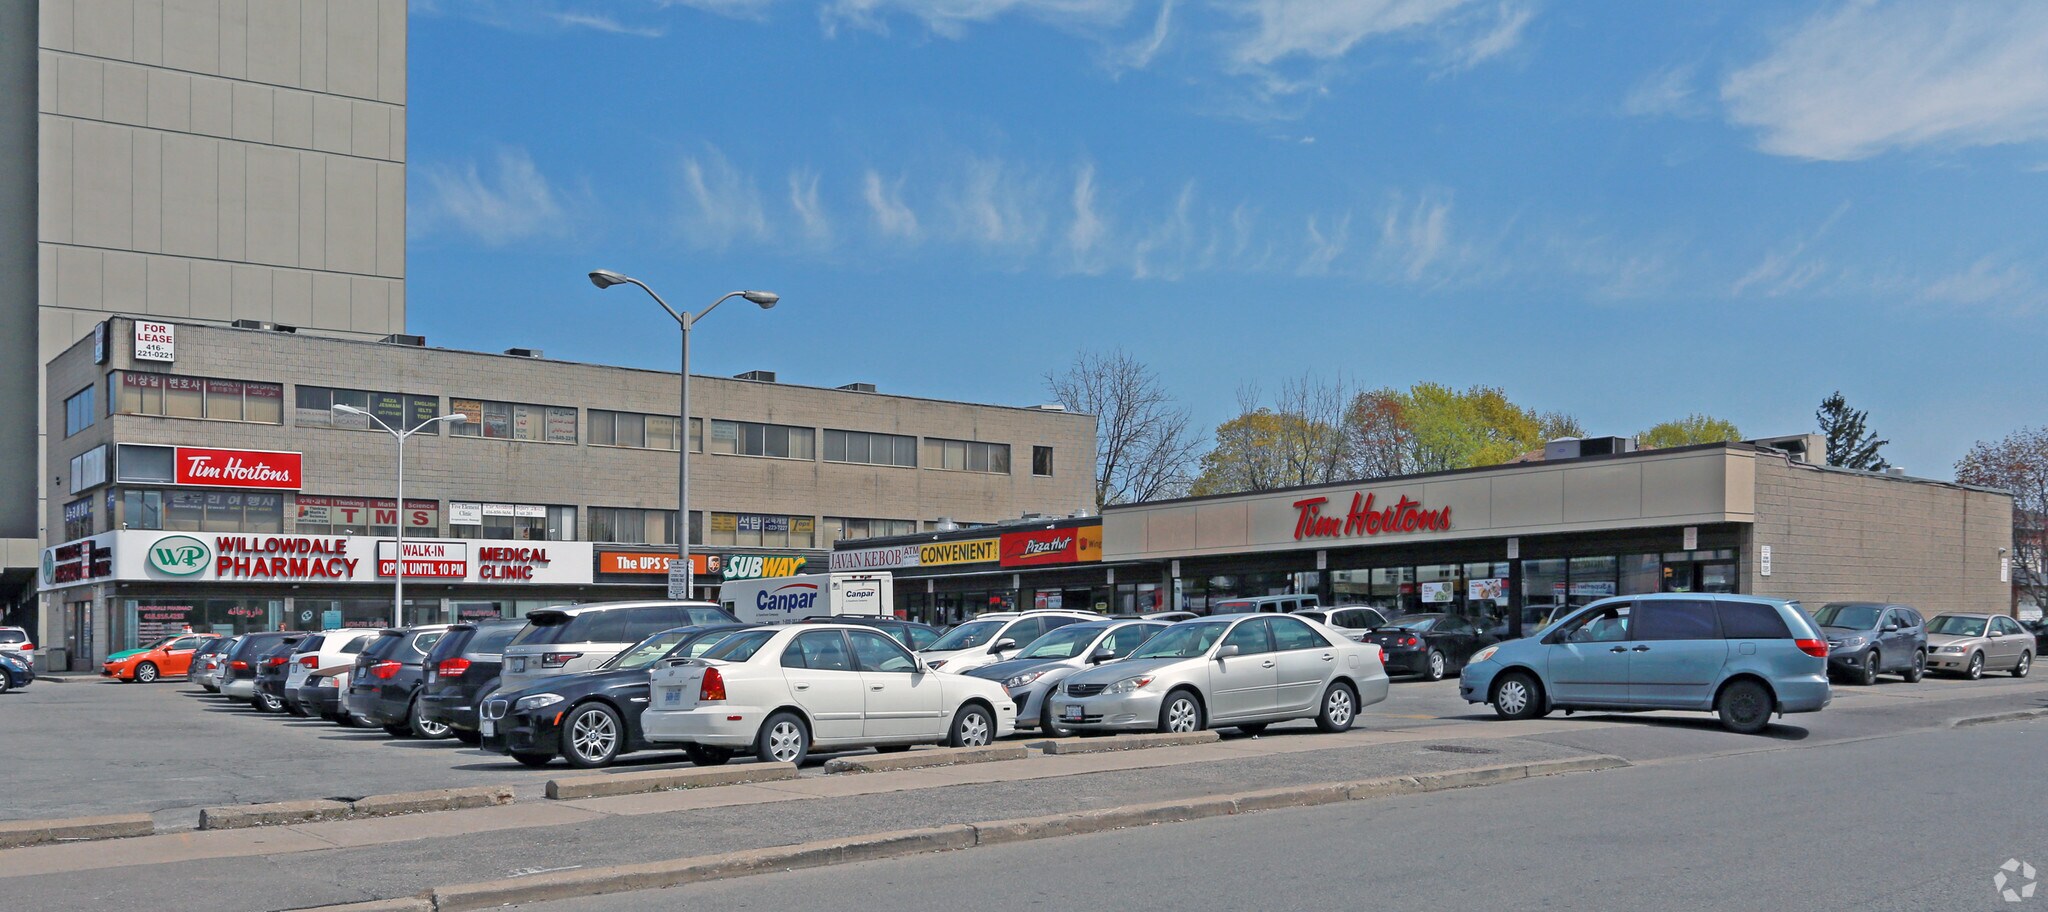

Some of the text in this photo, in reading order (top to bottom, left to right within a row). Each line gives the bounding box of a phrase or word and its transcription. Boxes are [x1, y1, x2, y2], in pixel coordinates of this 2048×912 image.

[144, 324, 166, 333] FOR
[138, 333, 172, 344] LEASE
[138, 350, 172, 358] 221-0221
[127, 374, 159, 387] 이상길
[169, 378, 200, 390] 변호사
[188, 456, 290, 482] Tim Hortons
[340, 509, 429, 525] T M S
[739, 516, 762, 530] 석탑
[1293, 491, 1452, 540] Tim Hortons
[216, 537, 347, 555] WILLOWDALE
[403, 544, 444, 557] WALK-IN
[904, 547, 919, 555] ATM
[921, 542, 992, 564] CONVENIENT
[1025, 536, 1072, 554] Pizza Hut
[156, 546, 204, 567] WP
[480, 547, 550, 562] MEDICAL
[830, 549, 902, 570] JAVAN KEBOB
[216, 556, 358, 578] PHARMACY
[382, 564, 464, 576] OPN UNTIL 10 PM
[617, 557, 637, 569] The
[640, 557, 660, 570] UPS
[724, 554, 807, 579] SUBWAY
[480, 565, 533, 580] CLINIC
[756, 590, 817, 613] Canpar
